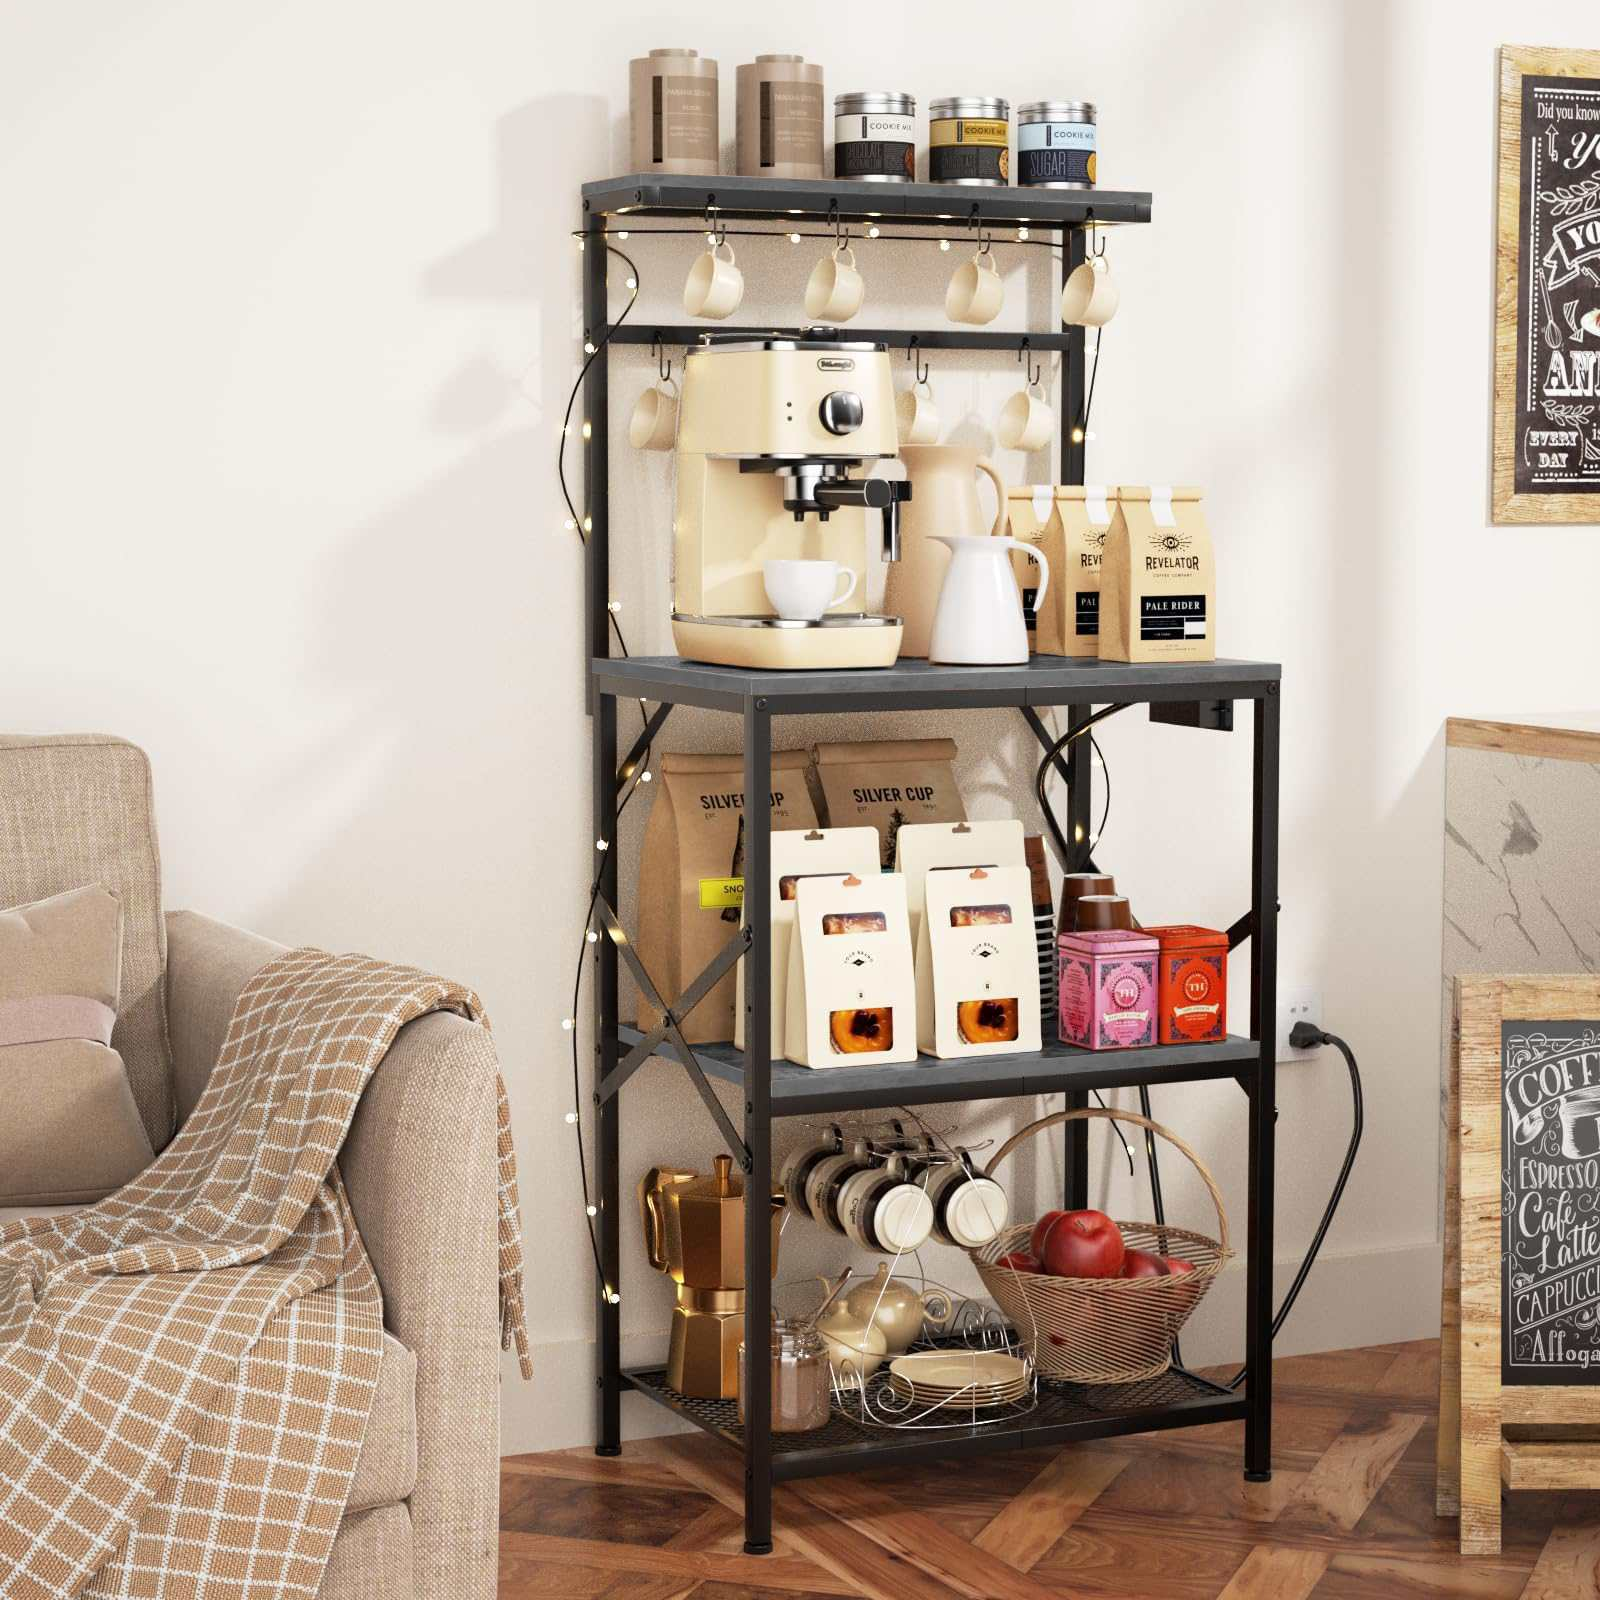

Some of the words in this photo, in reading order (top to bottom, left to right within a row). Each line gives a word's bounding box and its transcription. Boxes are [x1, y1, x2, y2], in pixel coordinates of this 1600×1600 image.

[1537, 102, 1554, 119] Did
[1556, 106, 1574, 123] you
[869, 122, 900, 131] COOKIE
[964, 127, 995, 135] COOKIE
[1053, 131, 1084, 139] COOKIE
[1563, 131, 1600, 170] Y
[1030, 151, 1066, 177] SUGAR
[1543, 350, 1600, 397] AN
[1529, 431, 1579, 446] EVERY
[1538, 453, 1569, 468] DAY
[1145, 555, 1200, 571] REVELATOR
[1145, 601, 1169, 611] PALE
[1171, 601, 1200, 610] RIDER
[853, 787, 903, 803] SILVER
[905, 786, 934, 801] CUP
[1518, 1051, 1600, 1107] COFF
[1516, 1215, 1600, 1274] Latte
